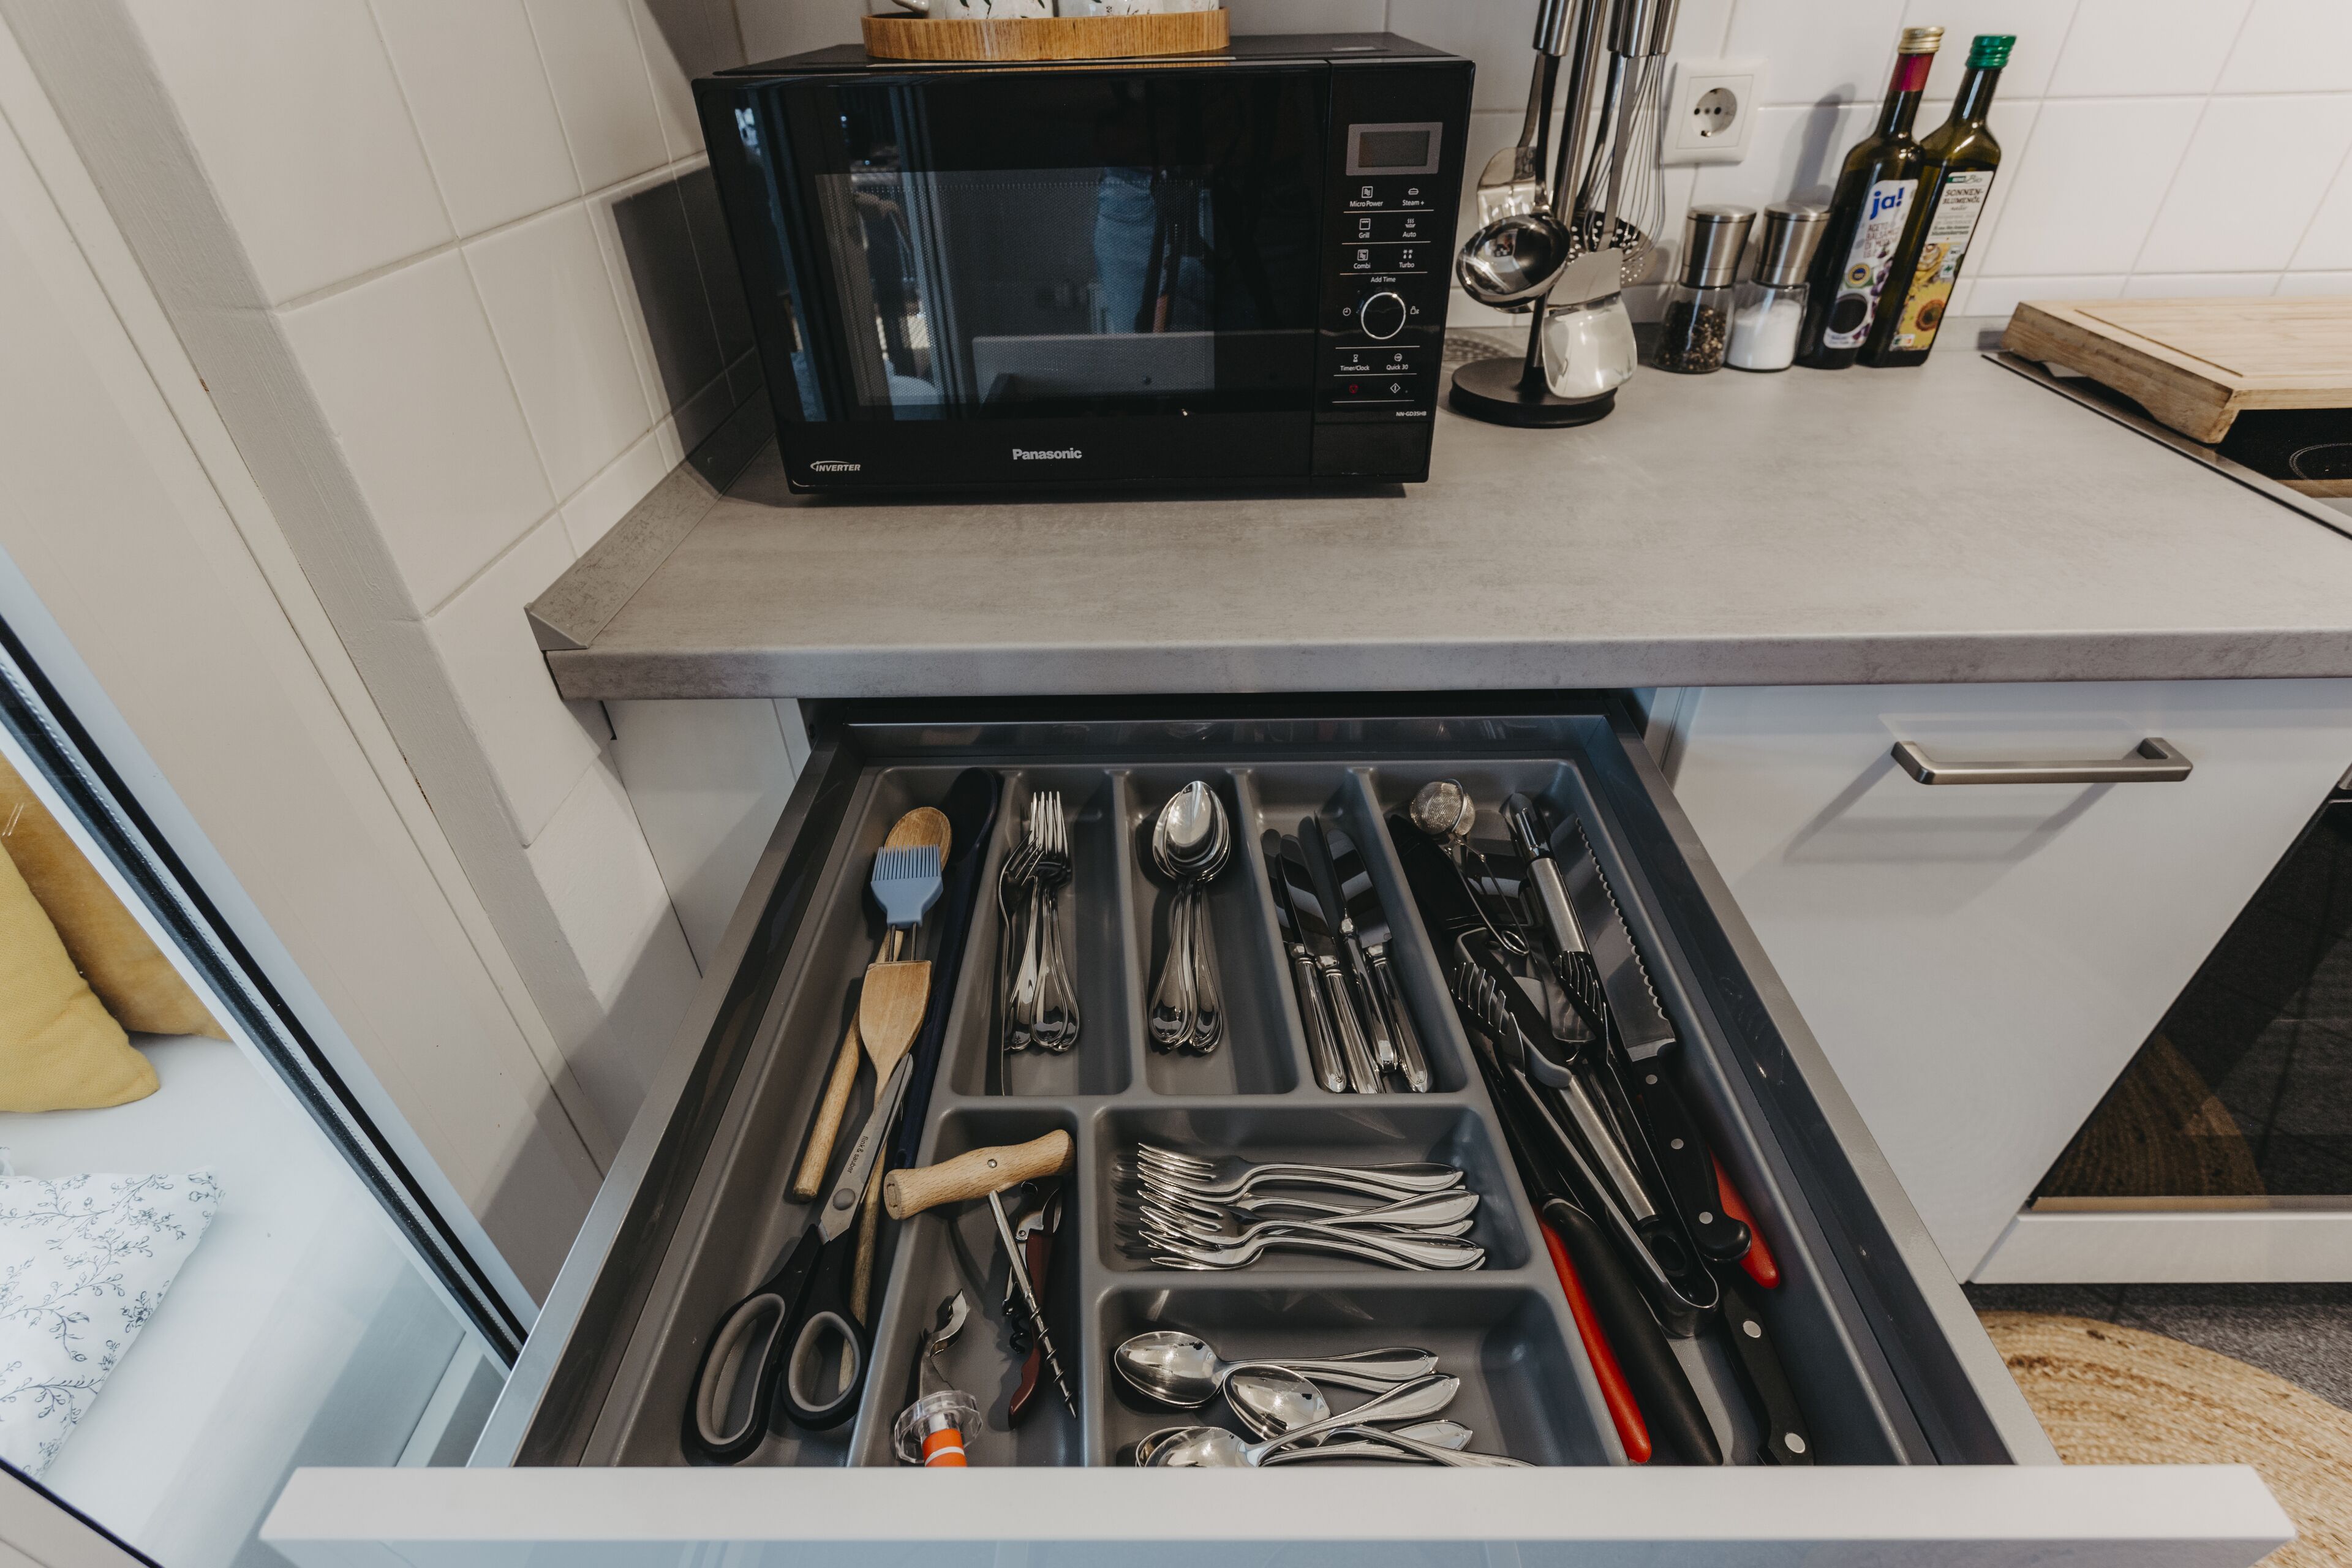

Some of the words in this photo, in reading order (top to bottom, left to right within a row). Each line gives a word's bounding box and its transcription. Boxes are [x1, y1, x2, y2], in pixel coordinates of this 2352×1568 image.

[1945, 188, 1984, 197] SONNEN-
[1869, 187, 1904, 221] ja!
[1012, 447, 1083, 461] Panasonic
[859, 1136, 869, 1148] flink
[847, 1153, 859, 1174] sauber
